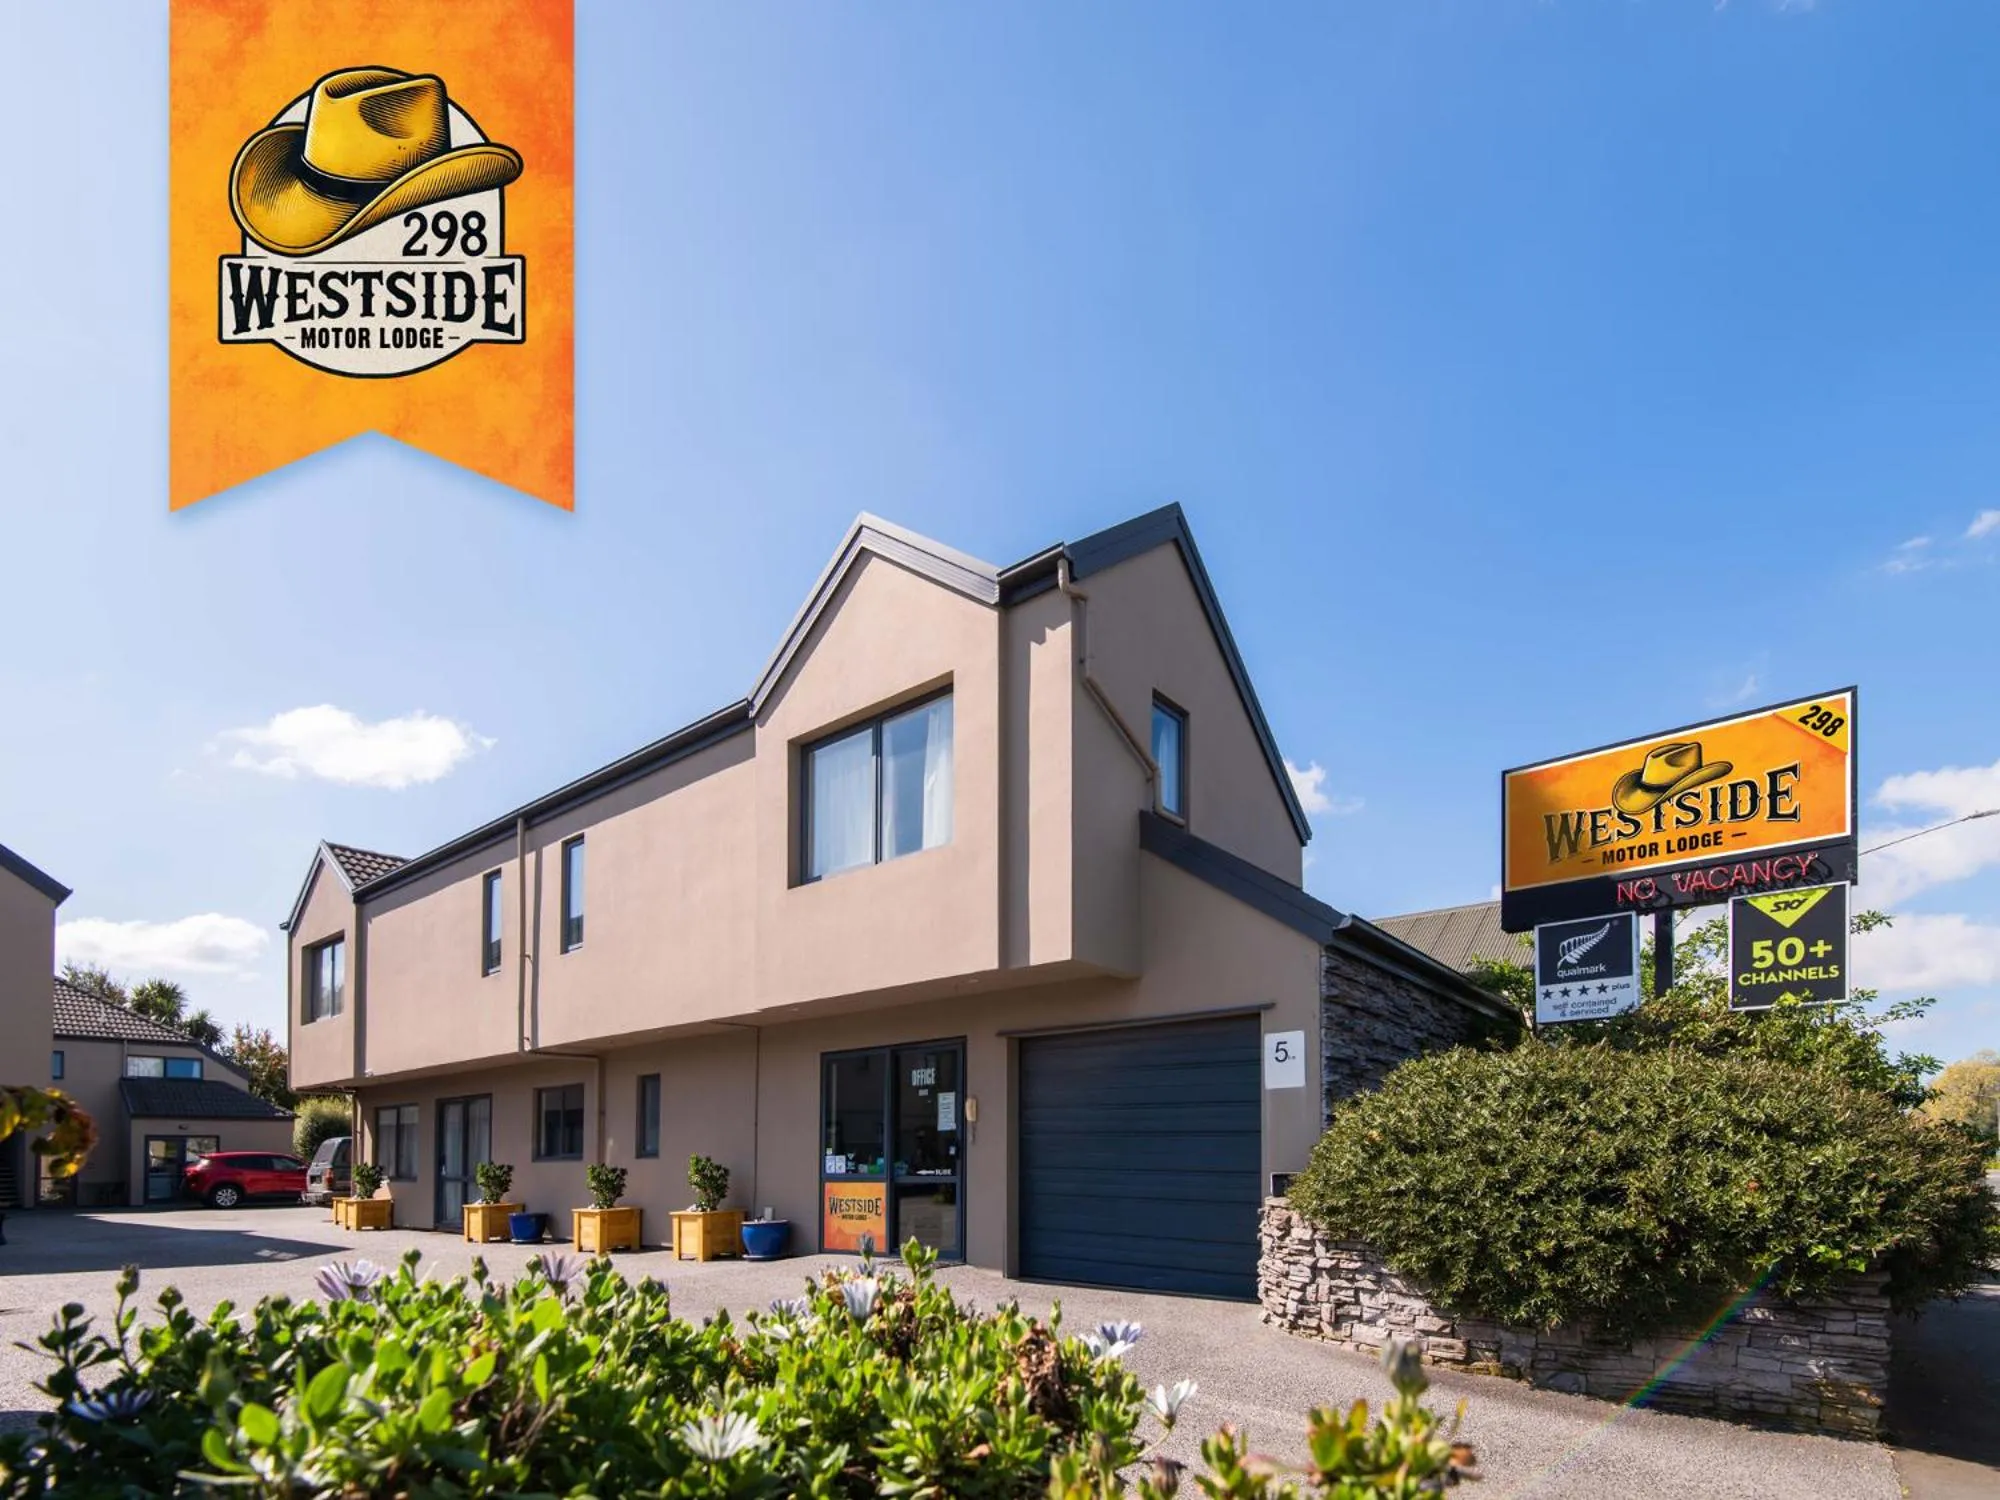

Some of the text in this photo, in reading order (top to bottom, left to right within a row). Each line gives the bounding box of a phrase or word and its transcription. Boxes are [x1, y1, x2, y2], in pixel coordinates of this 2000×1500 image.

[1798, 705, 1845, 738] 298
[1543, 760, 1801, 865] WESTSIDE
[1602, 830, 1723, 865] MOTOR LODGE
[1616, 852, 1819, 904] NO VACANCY
[1752, 936, 1833, 969] 50+
[1557, 963, 1607, 979] qualmark
[1738, 964, 1840, 986] CHANNELS
[1611, 982, 1631, 992] plus
[1570, 997, 1617, 1010] contained
[911, 1067, 936, 1087] OFFICE
[829, 1196, 882, 1217] WESTSIDE
